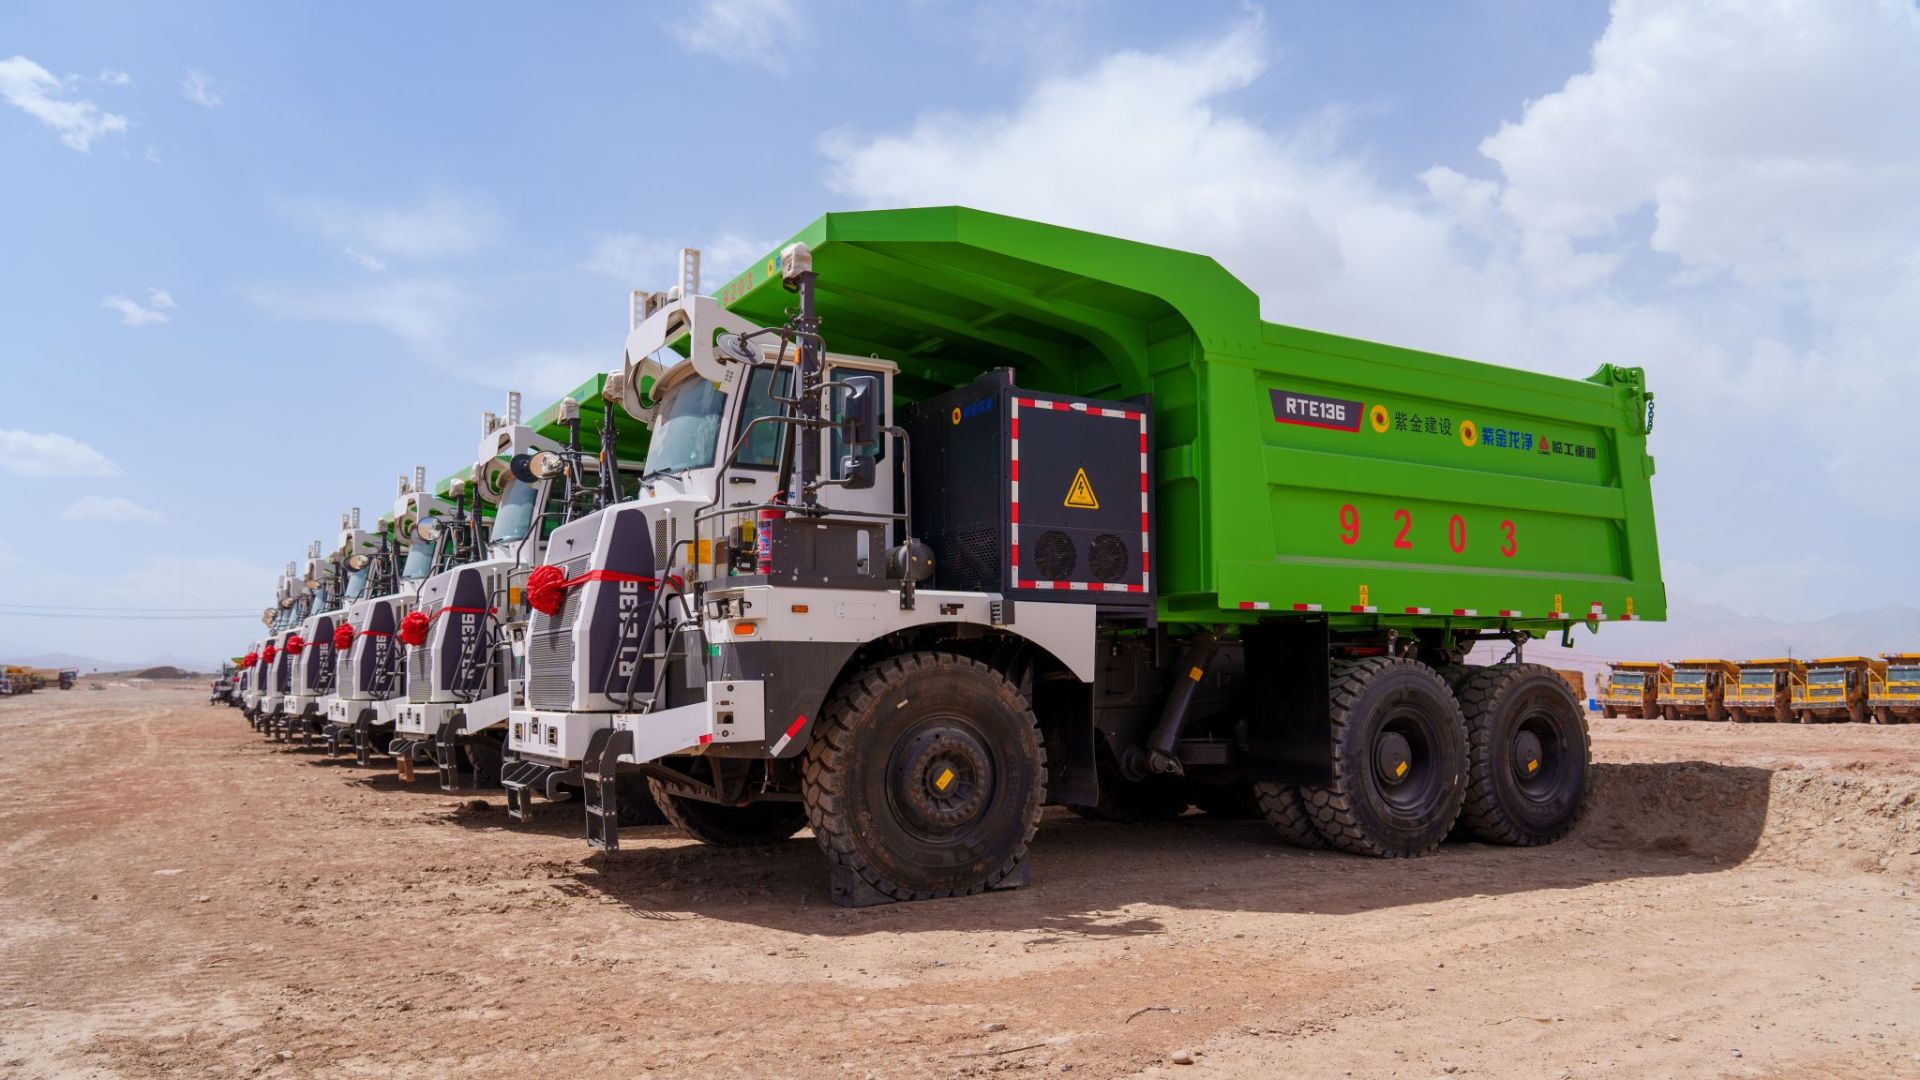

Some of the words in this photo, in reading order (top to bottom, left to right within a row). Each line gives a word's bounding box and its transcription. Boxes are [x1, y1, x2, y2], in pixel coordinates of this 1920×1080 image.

[1286, 397, 1345, 421] RTE136
[1394, 412, 1452, 436] 紫金建设
[1482, 426, 1533, 451] 紫金龙净
